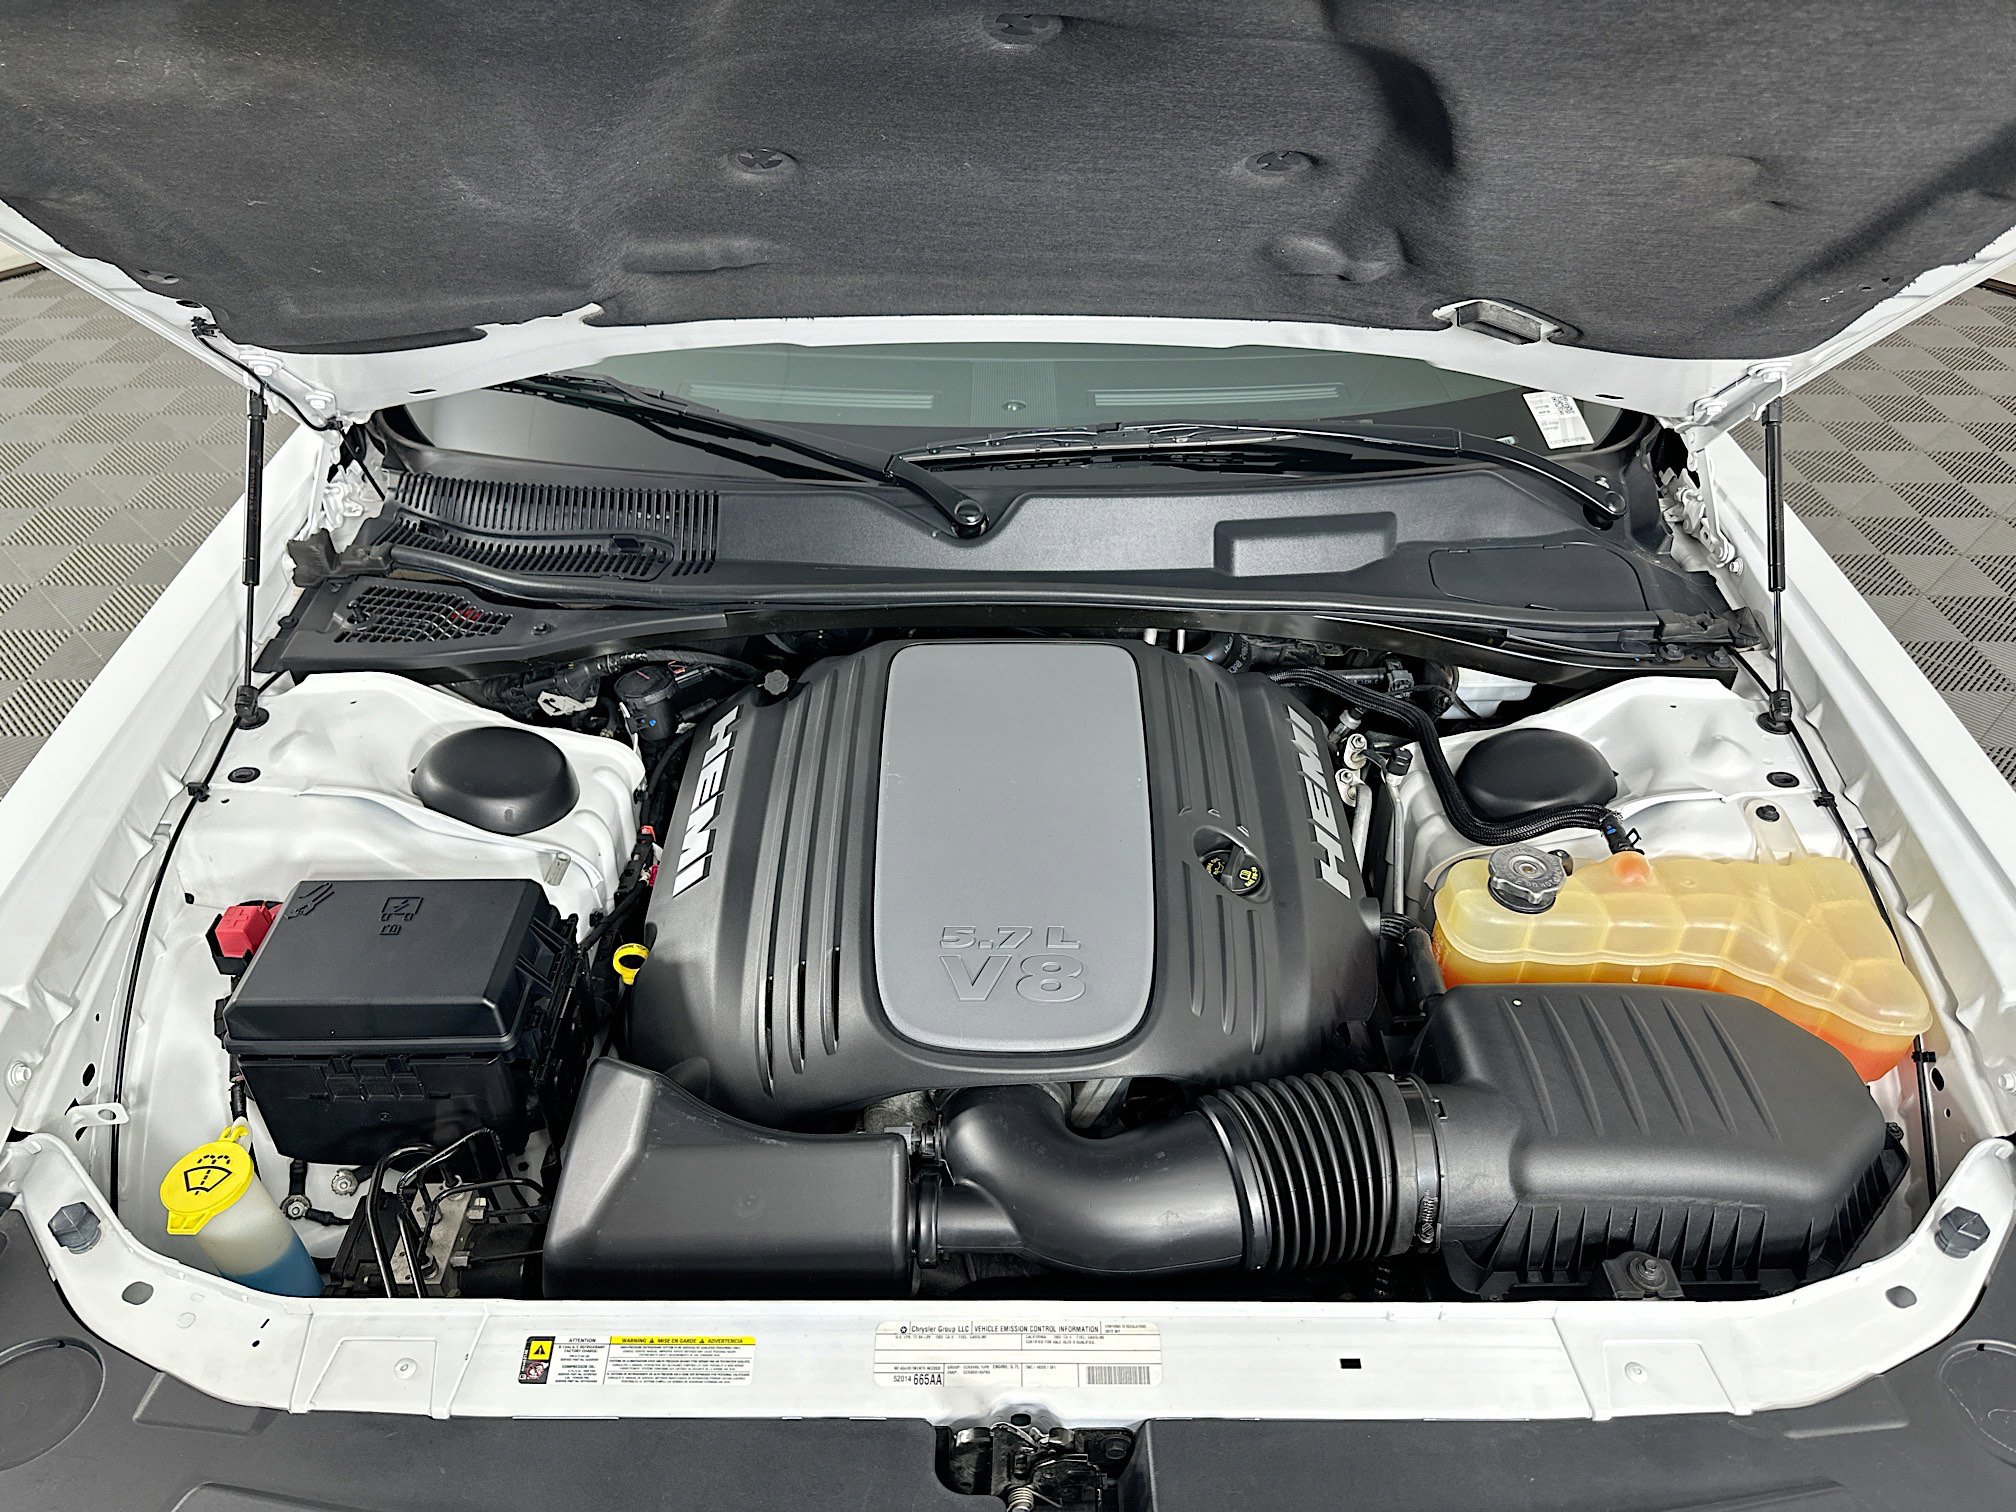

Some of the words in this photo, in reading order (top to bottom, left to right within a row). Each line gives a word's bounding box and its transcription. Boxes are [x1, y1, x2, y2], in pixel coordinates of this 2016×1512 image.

[672, 705, 740, 898] HEMI
[1286, 704, 1352, 899] HEMI
[939, 953, 1087, 1003] V8
[911, 1325, 936, 1333] Chrysler
[937, 1325, 956, 1333] Group
[958, 1325, 969, 1333] LLC
[913, 1374, 942, 1385] 665AA
